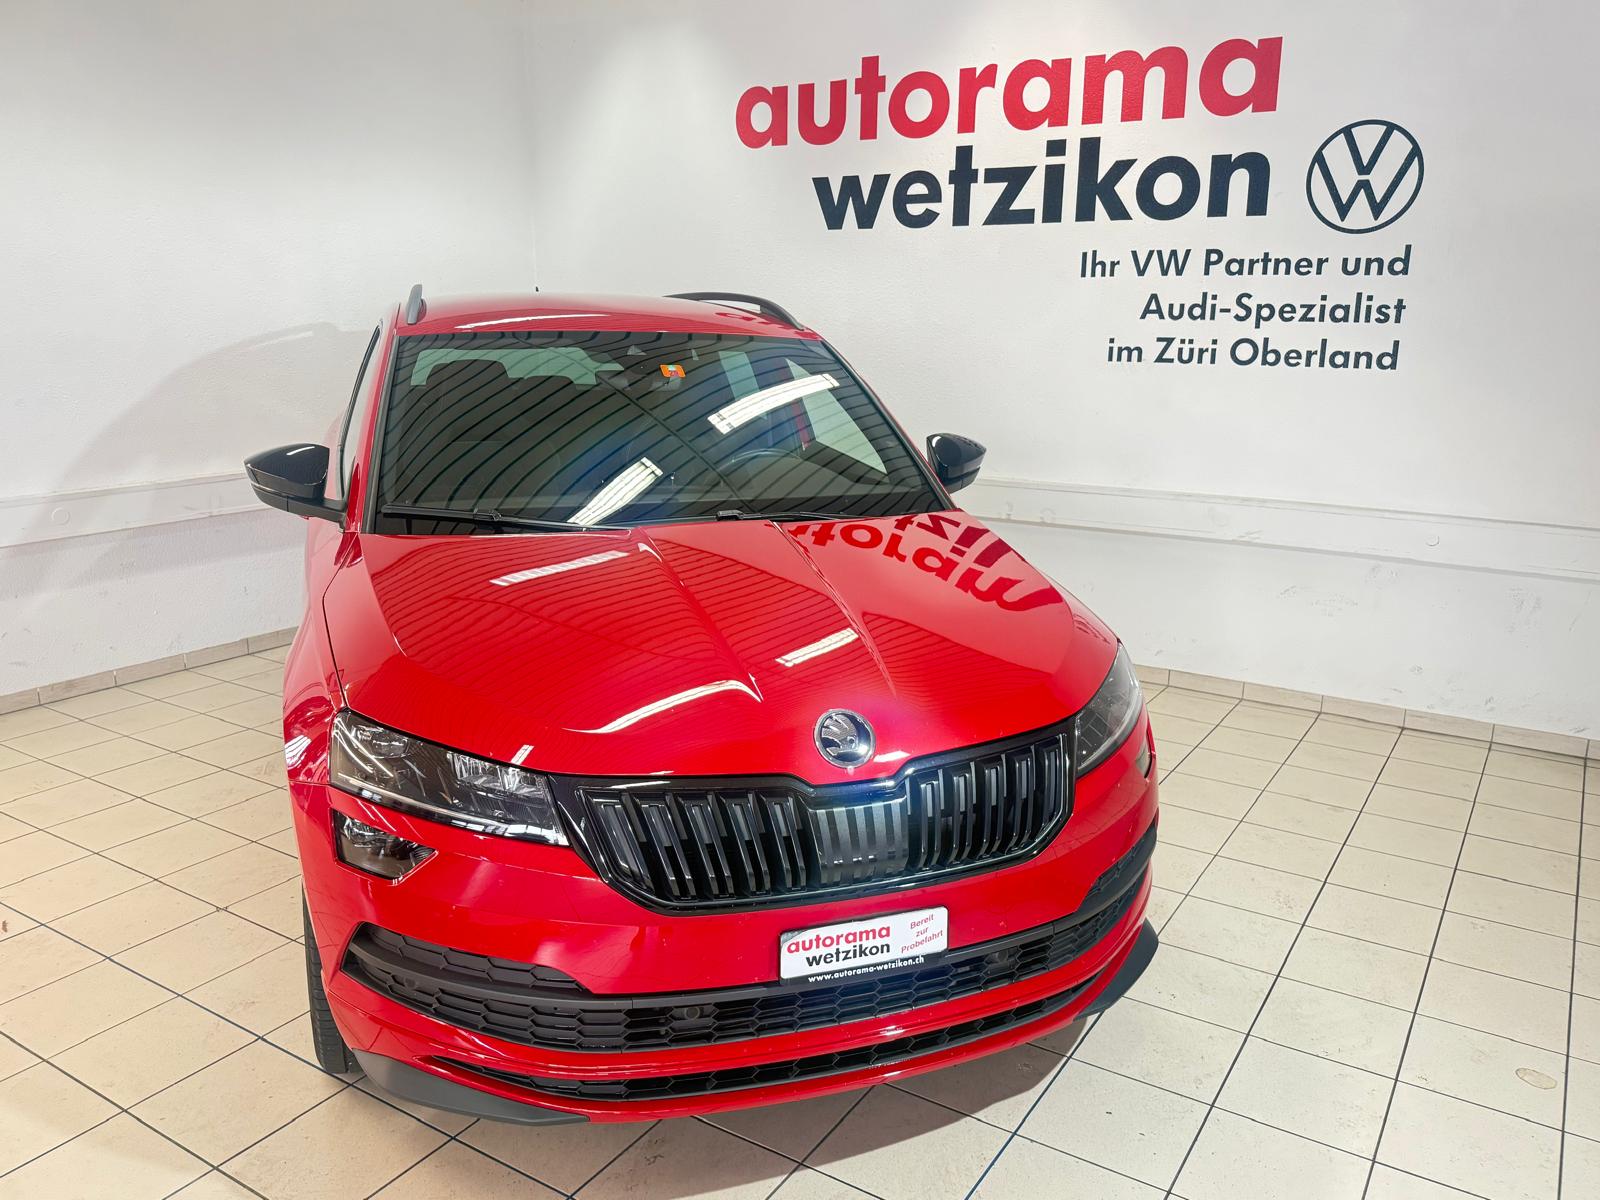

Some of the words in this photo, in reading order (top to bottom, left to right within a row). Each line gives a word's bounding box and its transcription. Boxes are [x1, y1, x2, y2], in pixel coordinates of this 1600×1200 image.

[735, 36, 1283, 149] autorama
[811, 137, 1271, 231] wetzikon
[1080, 249, 1120, 278] Ihr
[1130, 248, 1192, 277] VW
[1203, 248, 1329, 276] Partner
[1341, 244, 1412, 276] und
[1139, 291, 1407, 329] Audi-Spezialist
[1107, 337, 1143, 363] im
[1153, 336, 1218, 365] Züri
[1229, 337, 1400, 371] Oberland
[910, 914, 934, 930] Bereit
[916, 927, 929, 937] zur
[787, 926, 891, 954] autorama
[901, 930, 943, 954] Probefahrt
[805, 943, 891, 967] wetzikon
[807, 955, 925, 983] www.autorama-wetzikon.ch
